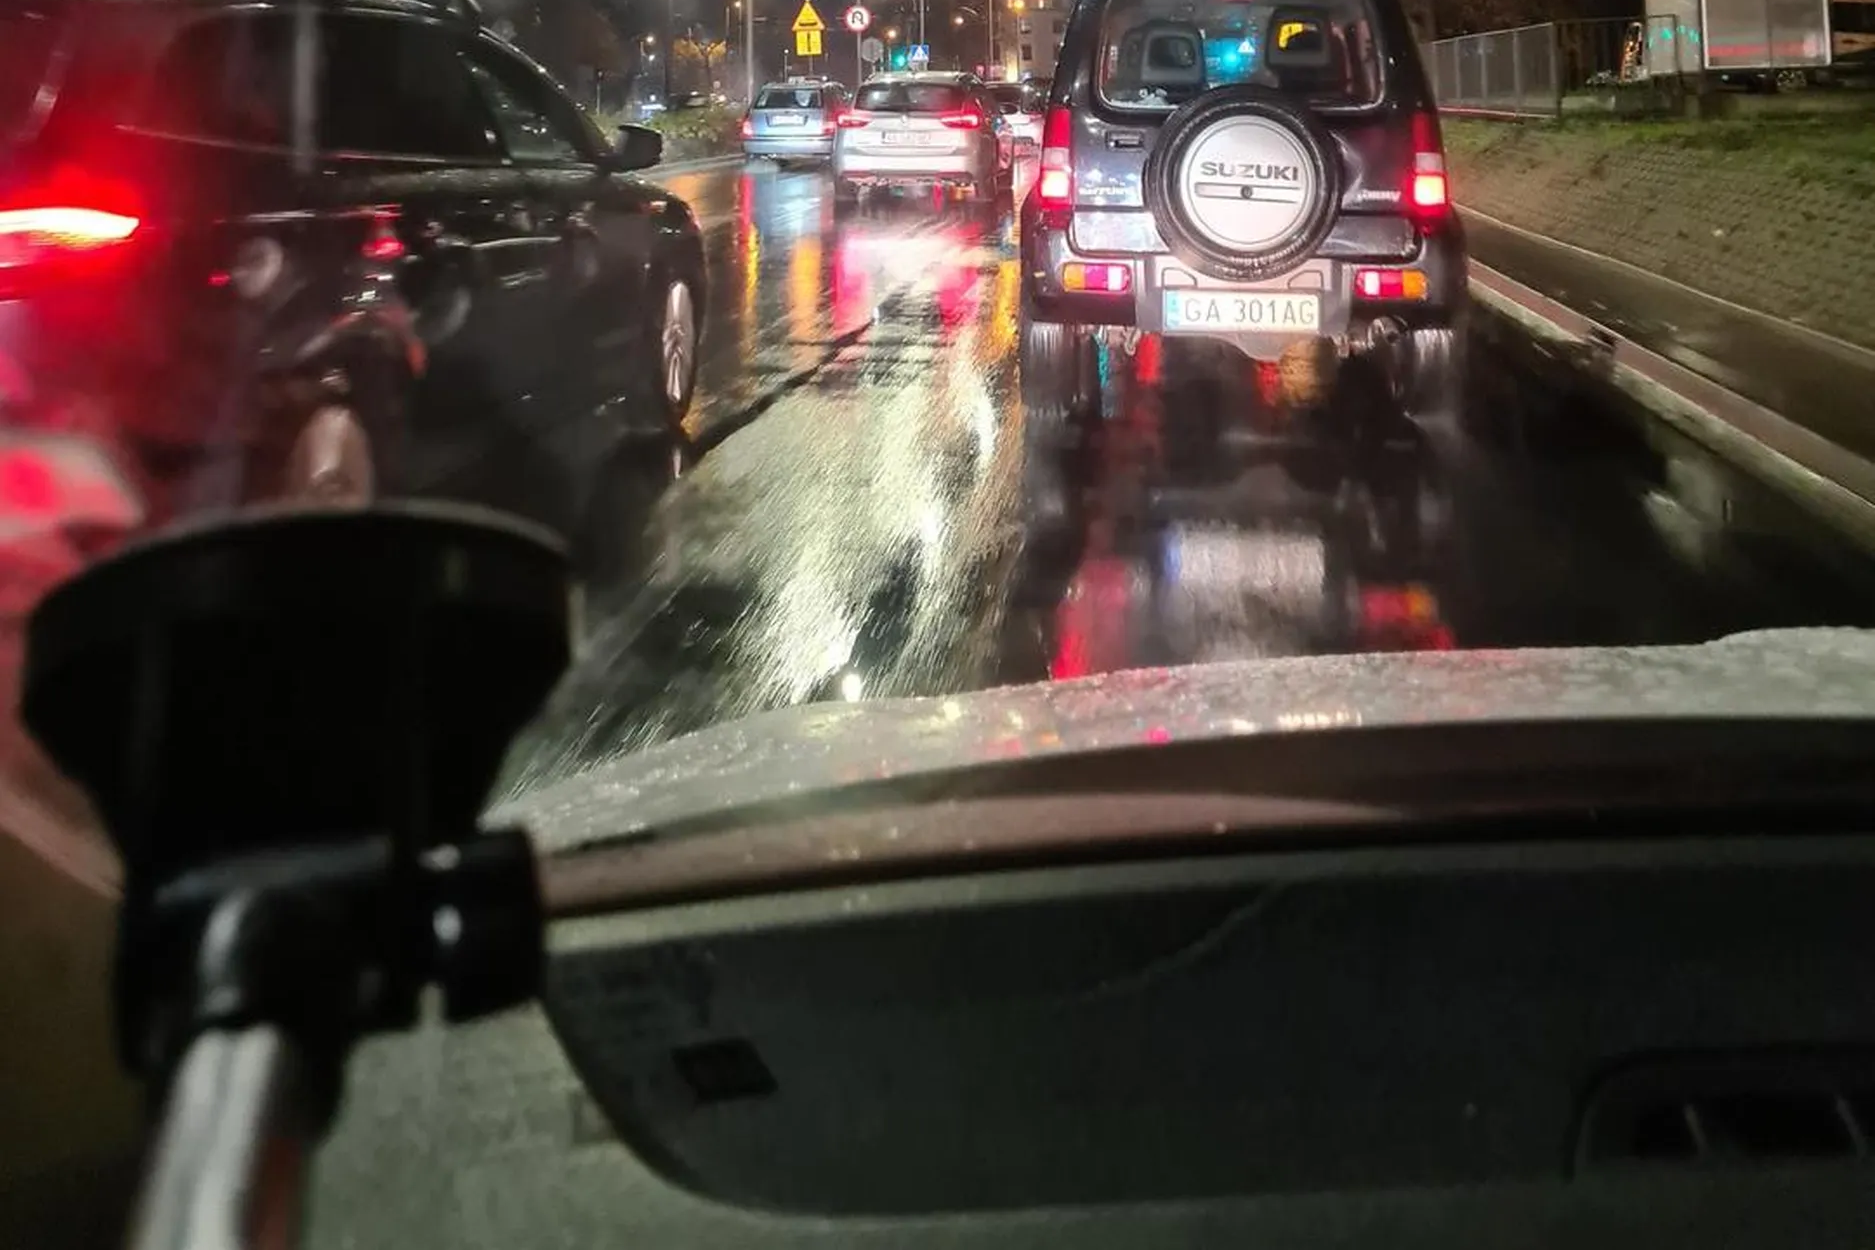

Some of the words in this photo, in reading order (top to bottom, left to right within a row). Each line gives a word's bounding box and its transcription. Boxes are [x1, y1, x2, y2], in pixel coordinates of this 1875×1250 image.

[1200, 161, 1299, 181] SUZUKI
[1185, 298, 1221, 323] GA
[1234, 299, 1315, 324] 301AG
